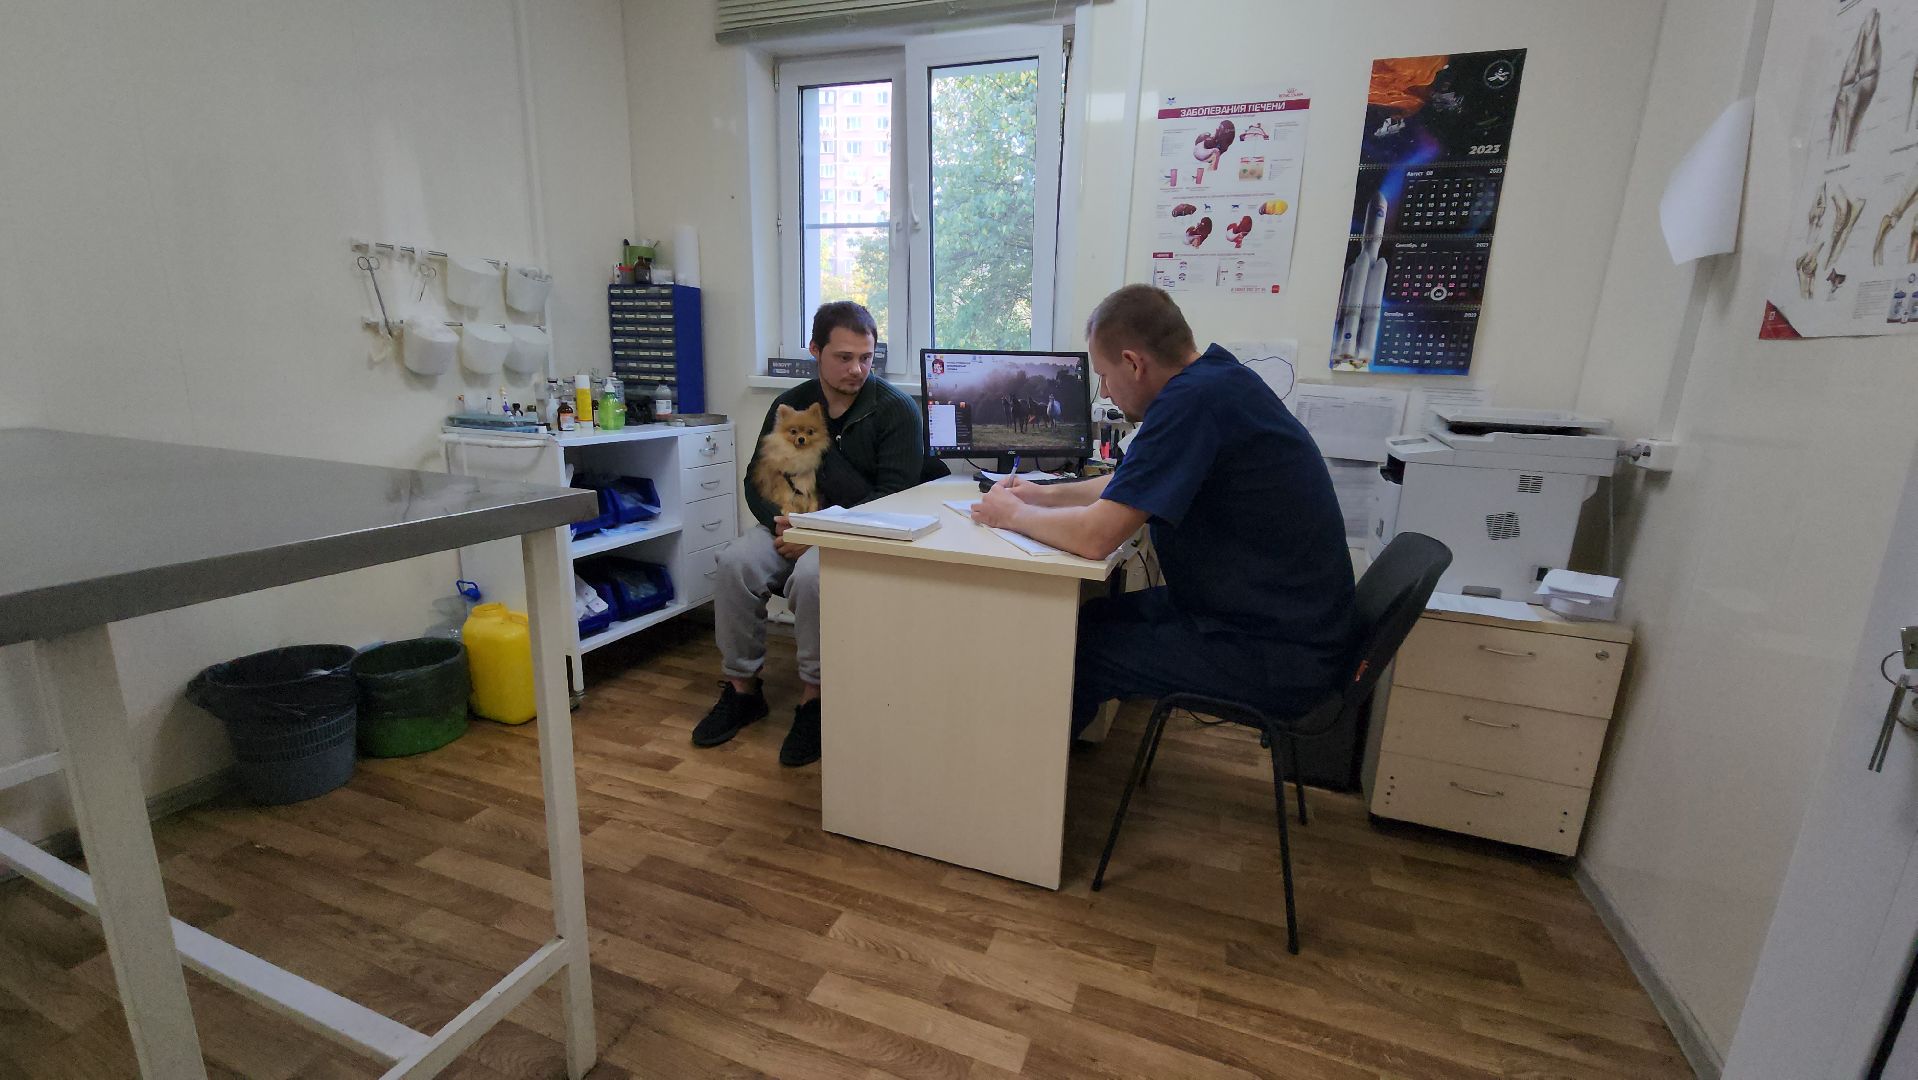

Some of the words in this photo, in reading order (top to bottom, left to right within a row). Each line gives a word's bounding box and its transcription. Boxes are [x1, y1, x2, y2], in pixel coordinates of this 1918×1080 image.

[1180, 104, 1246, 117] ЗАБОЛЕВАНИЯ
[1248, 102, 1286, 112] ПЕЧЕНИ
[1468, 144, 1501, 155] 2023
